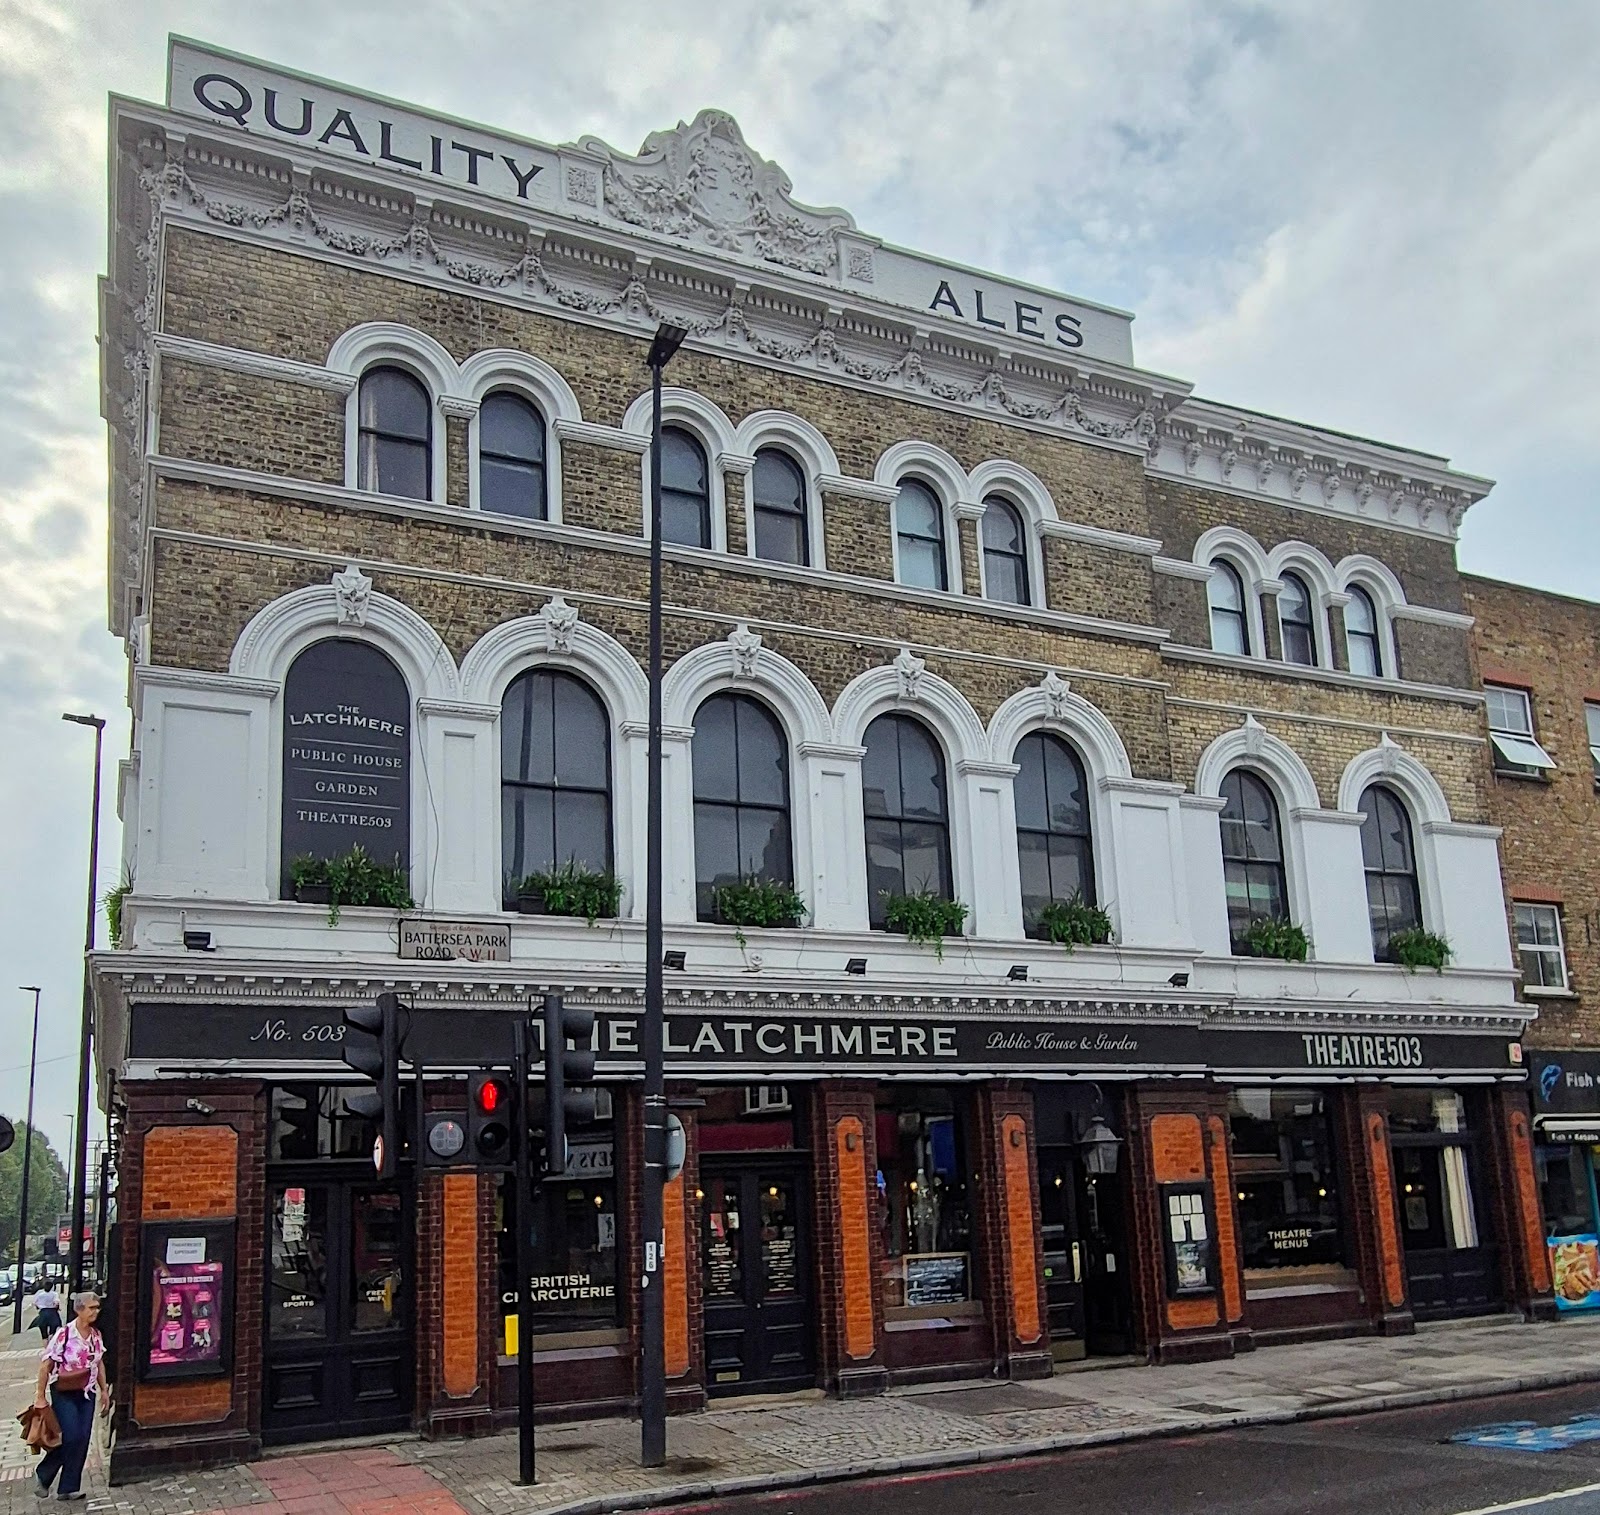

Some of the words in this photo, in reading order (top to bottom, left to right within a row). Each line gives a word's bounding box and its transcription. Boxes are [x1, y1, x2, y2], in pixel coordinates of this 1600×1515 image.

[193, 73, 544, 200] QUALITY
[929, 280, 1083, 348] ALES
[337, 704, 360, 714] THE
[290, 713, 405, 737] LATCHMERE
[291, 748, 346, 763] PUBLIC
[353, 754, 402, 768] HOUSE
[315, 781, 378, 796] GARDEN
[297, 810, 392, 828] THEATRE503
[404, 931, 473, 946] BATTERSEA
[476, 934, 507, 948] PARK
[250, 1019, 291, 1041] No.
[302, 1025, 347, 1041] 503
[662, 1021, 958, 1057] LATCHMERE
[985, 1031, 1032, 1050] Public
[1034, 1032, 1077, 1050] House
[1079, 1036, 1092, 1050] &
[1093, 1033, 1139, 1050] Garden
[1302, 1034, 1423, 1067] THEATRE503
[1565, 1071, 1593, 1088] Fish
[1267, 1229, 1312, 1241] THEATRE
[1274, 1240, 1309, 1250] MENUS
[531, 1274, 590, 1288] BRITISH
[283, 1300, 315, 1308] SPORTS
